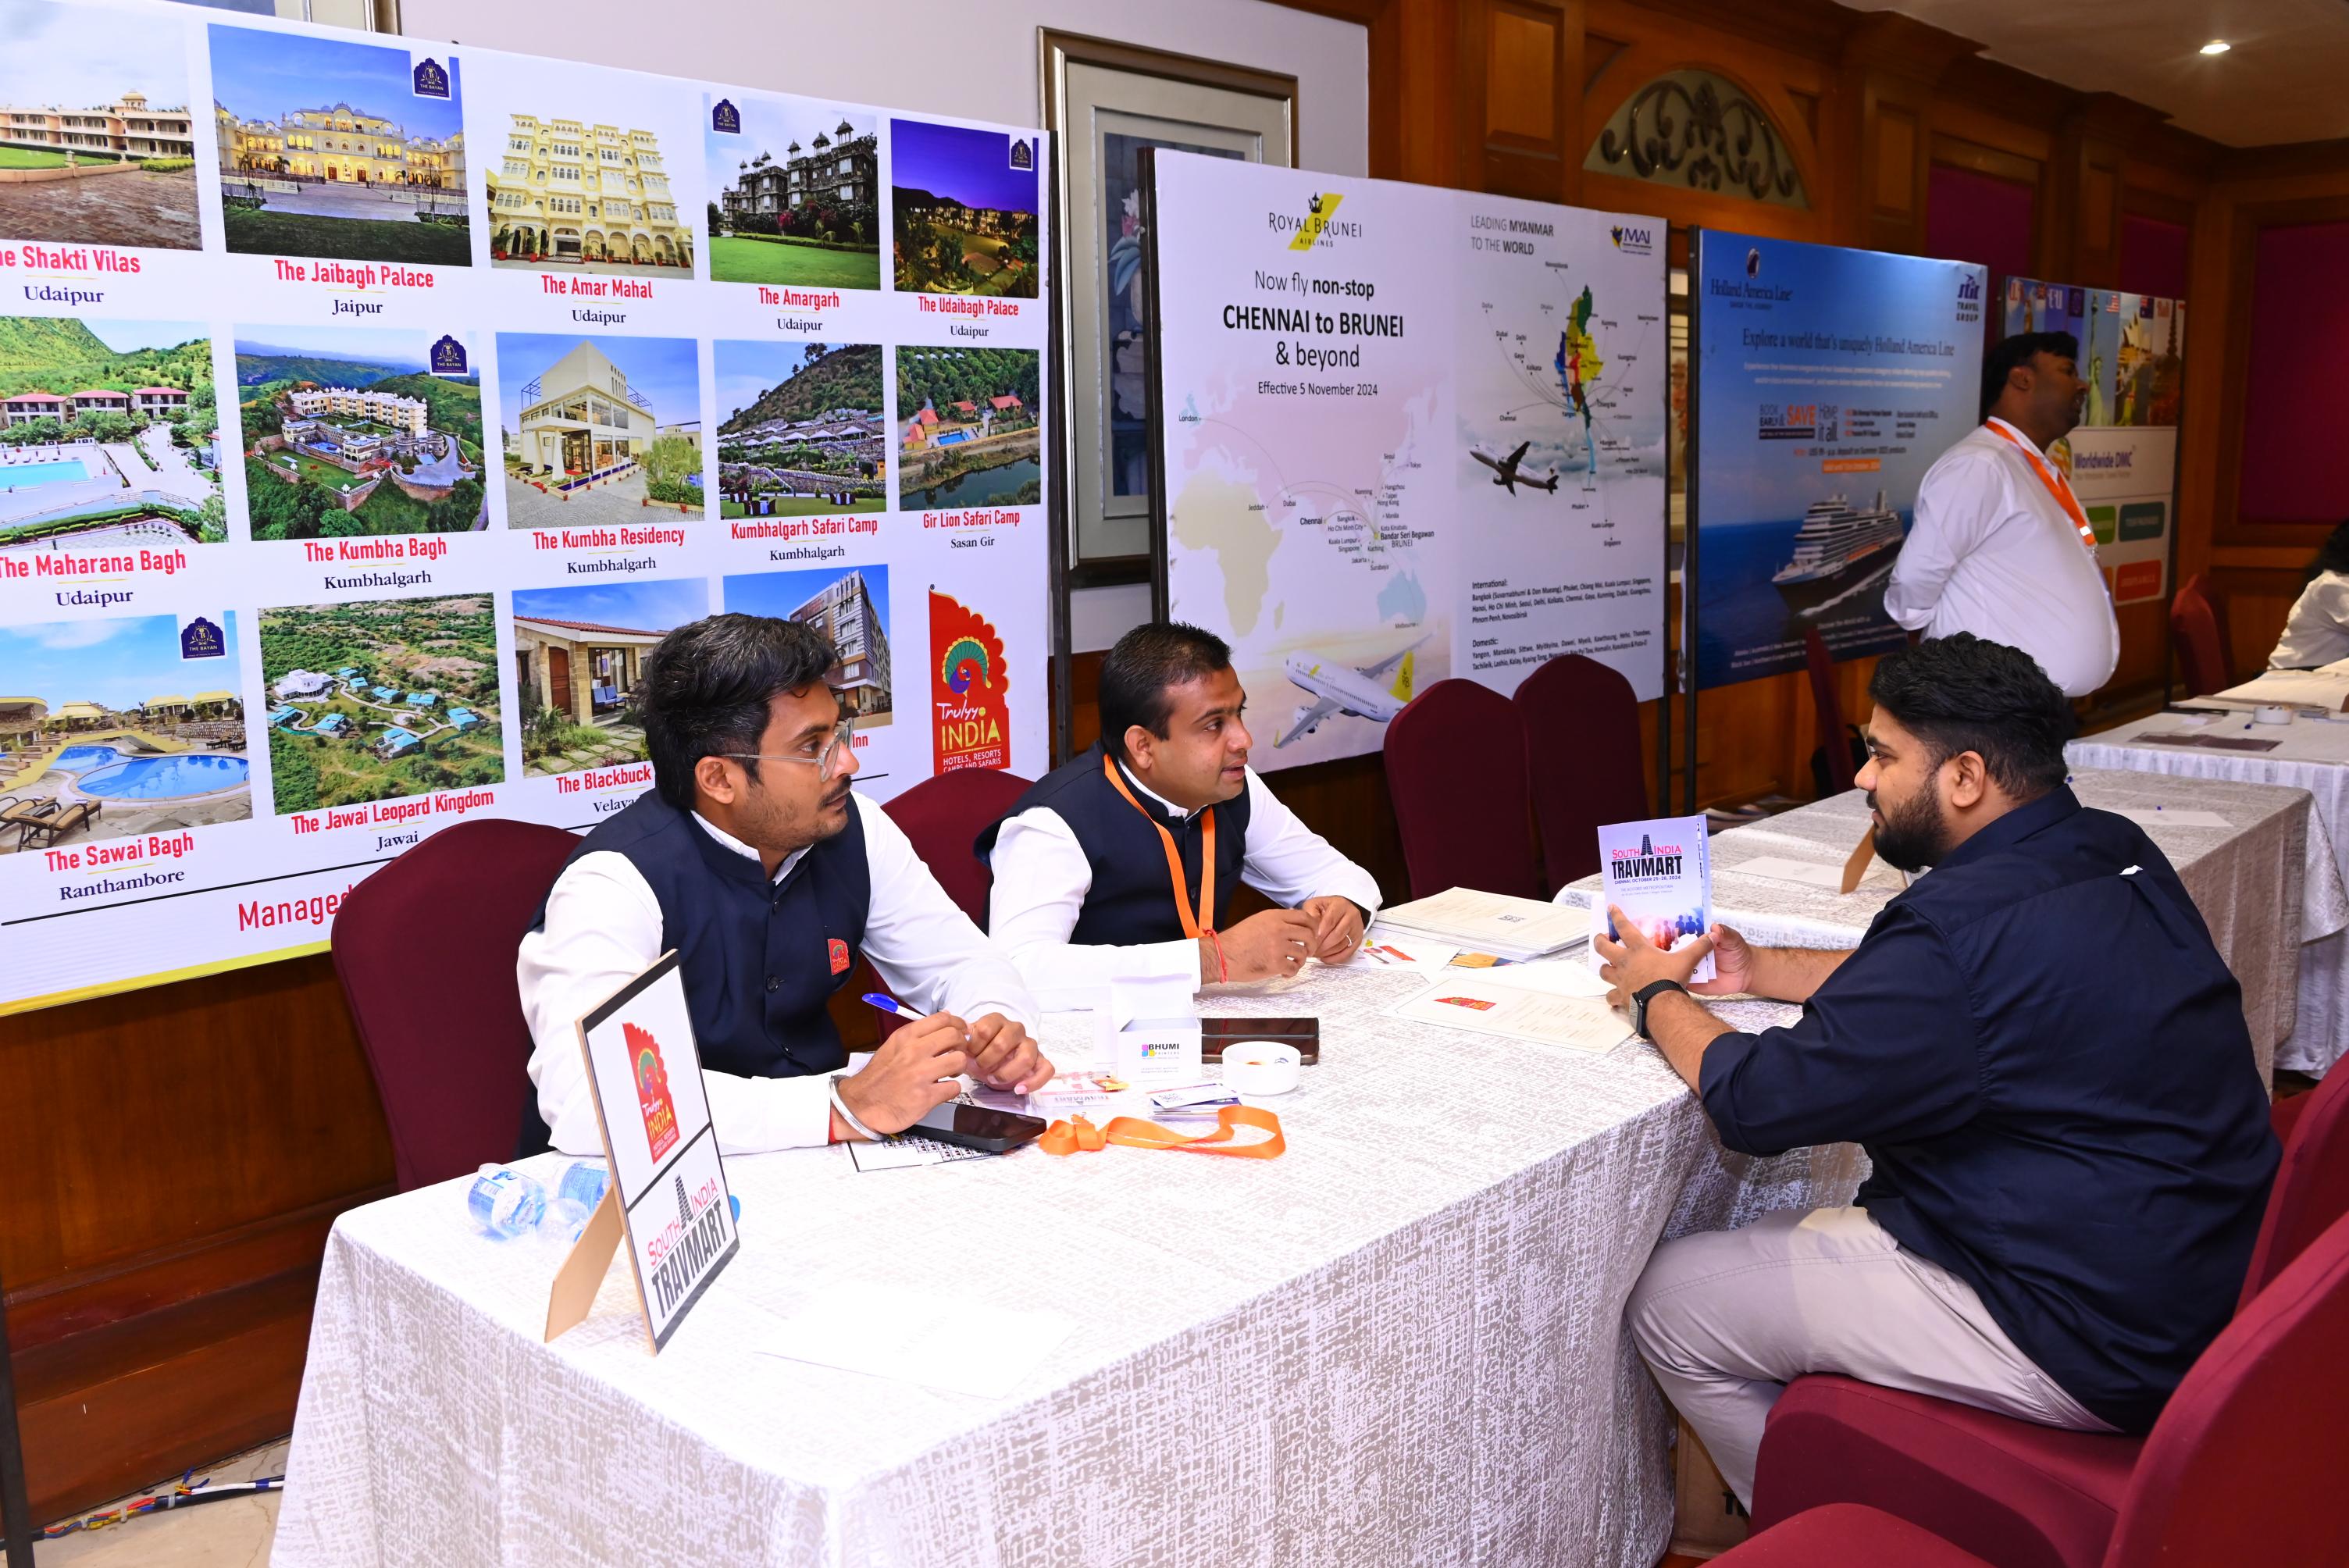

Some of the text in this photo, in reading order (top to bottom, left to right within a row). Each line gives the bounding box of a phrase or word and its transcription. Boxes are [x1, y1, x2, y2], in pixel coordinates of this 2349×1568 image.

[1269, 212, 1362, 238] ROYAL BRUNEI
[1471, 215, 1554, 237] LEADING MYANMAR
[1624, 228, 1651, 244] MAI
[1299, 237, 1334, 248] AIRLINES
[1471, 237, 1535, 255] TO THE WORLD
[22, 245, 88, 270] Shakti
[93, 249, 141, 273] Vilas
[274, 259, 434, 290] The Jaibagh Palace
[1255, 270, 1374, 301] Now fly non-stop
[23, 285, 105, 306] Udaipur
[541, 275, 653, 298] The Amar Mahal
[332, 299, 383, 317] Jaipur
[758, 287, 839, 312] The Amargarh
[918, 296, 1019, 318] The Udaibagh Palace
[572, 309, 627, 326] Udaipur
[777, 318, 823, 333] Udaipur
[1223, 305, 1404, 337] CHENNAI to BRUNEI
[950, 326, 989, 339] Udaipur
[1743, 328, 1955, 356] Explore a world that's uniquely Holland America Line
[1276, 341, 1360, 372] & beyond
[1258, 381, 1378, 396] Effective 5 November 2024
[1787, 404, 1816, 426] SAVE
[2074, 451, 2133, 469] Worldwide DMC
[731, 517, 879, 540] Kumbhalgarh Safari Camp
[923, 510, 1020, 529] Gir Lion Safari Camp
[533, 526, 685, 550] The Kumbha Residency
[950, 536, 995, 550] Sasan Gir
[1381, 530, 1435, 540] Bandar Seri Begawan
[1392, 540, 1413, 548] BRUNEI
[305, 537, 447, 562] The Kumbha Bagh
[769, 545, 845, 561] Kumbhalgarh
[36, 554, 134, 576] Maharana
[140, 549, 187, 576] Bagh
[567, 557, 656, 573] Kumbhalgarh
[324, 570, 432, 589] Kumbhalgarh
[56, 590, 134, 608] Udaipur
[936, 700, 979, 721] Trulyy
[853, 733, 868, 748] Inn
[942, 718, 1000, 750] INDIA
[943, 749, 1001, 766] HOTELS, RESORTS
[978, 759, 1001, 768] SAFARIS
[556, 764, 651, 793] The Blackbuck
[291, 789, 494, 834] The Jawai Leopard Kingdom
[45, 832, 194, 872] The Sawai Bagh
[376, 831, 419, 852] Jawai
[1613, 843, 1681, 859] SOUTH INDIA
[1612, 856, 1683, 880] TRAVMART
[59, 871, 185, 900] Ranthambore
[647, 1104, 673, 1141] INDIA
[647, 1177, 718, 1266] SOUTH INDIA
[651, 1199, 726, 1319] TRAVMART
